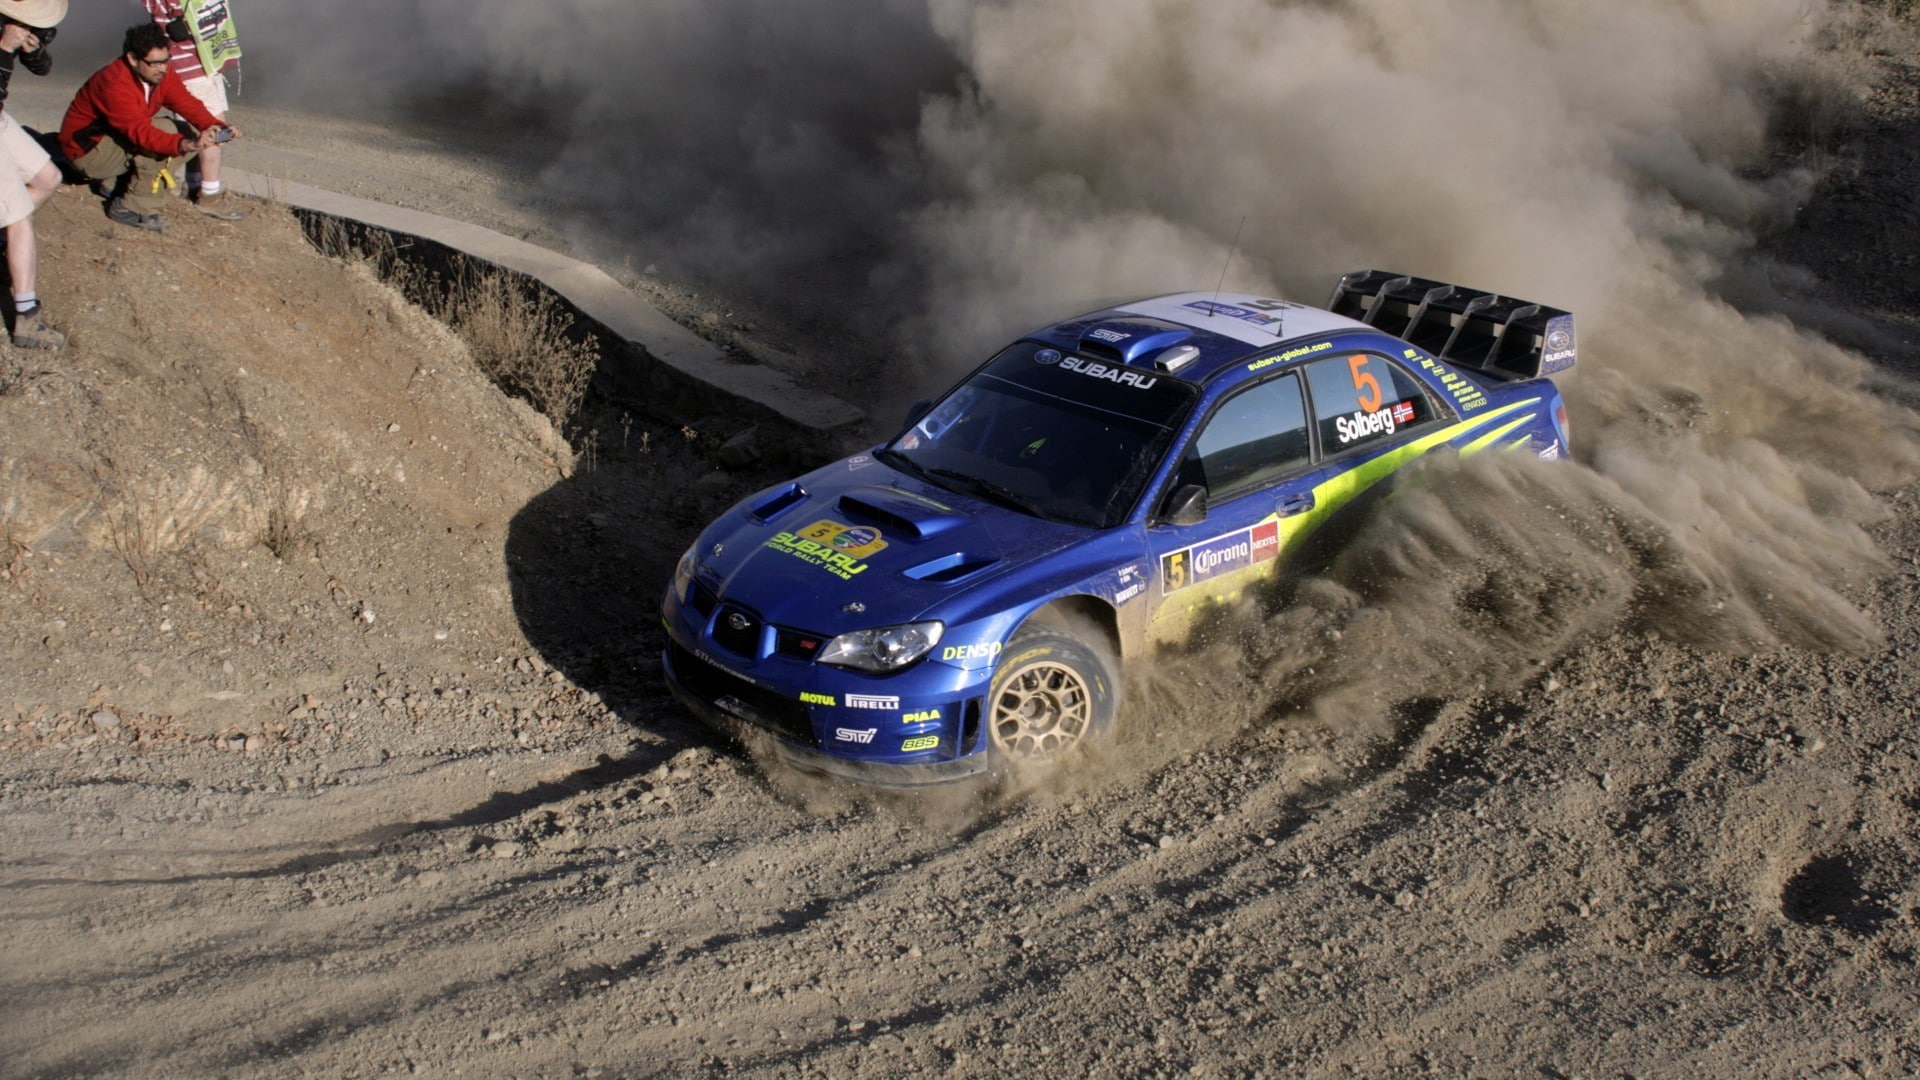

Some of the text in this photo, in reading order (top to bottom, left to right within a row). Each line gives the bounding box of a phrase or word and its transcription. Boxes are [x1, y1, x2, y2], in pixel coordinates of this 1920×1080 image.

[1248, 341, 1332, 371] subaru-global.com
[1545, 349, 1575, 362] SUBARU
[1059, 356, 1157, 390] SUBARU
[1347, 354, 1382, 413] 5
[1336, 407, 1396, 443] Solberg
[811, 529, 830, 538] 5
[771, 531, 869, 575] SUBARU
[1170, 535, 1278, 589] 5 Corona NEXTEL
[793, 552, 824, 566] RALLY
[823, 564, 853, 581] TEAM
[942, 642, 1002, 661] DENSO
[800, 692, 836, 706] MOTUL
[845, 693, 900, 710] PIRELLI
[902, 709, 941, 724] PIAA
[904, 737, 937, 750] BBS
